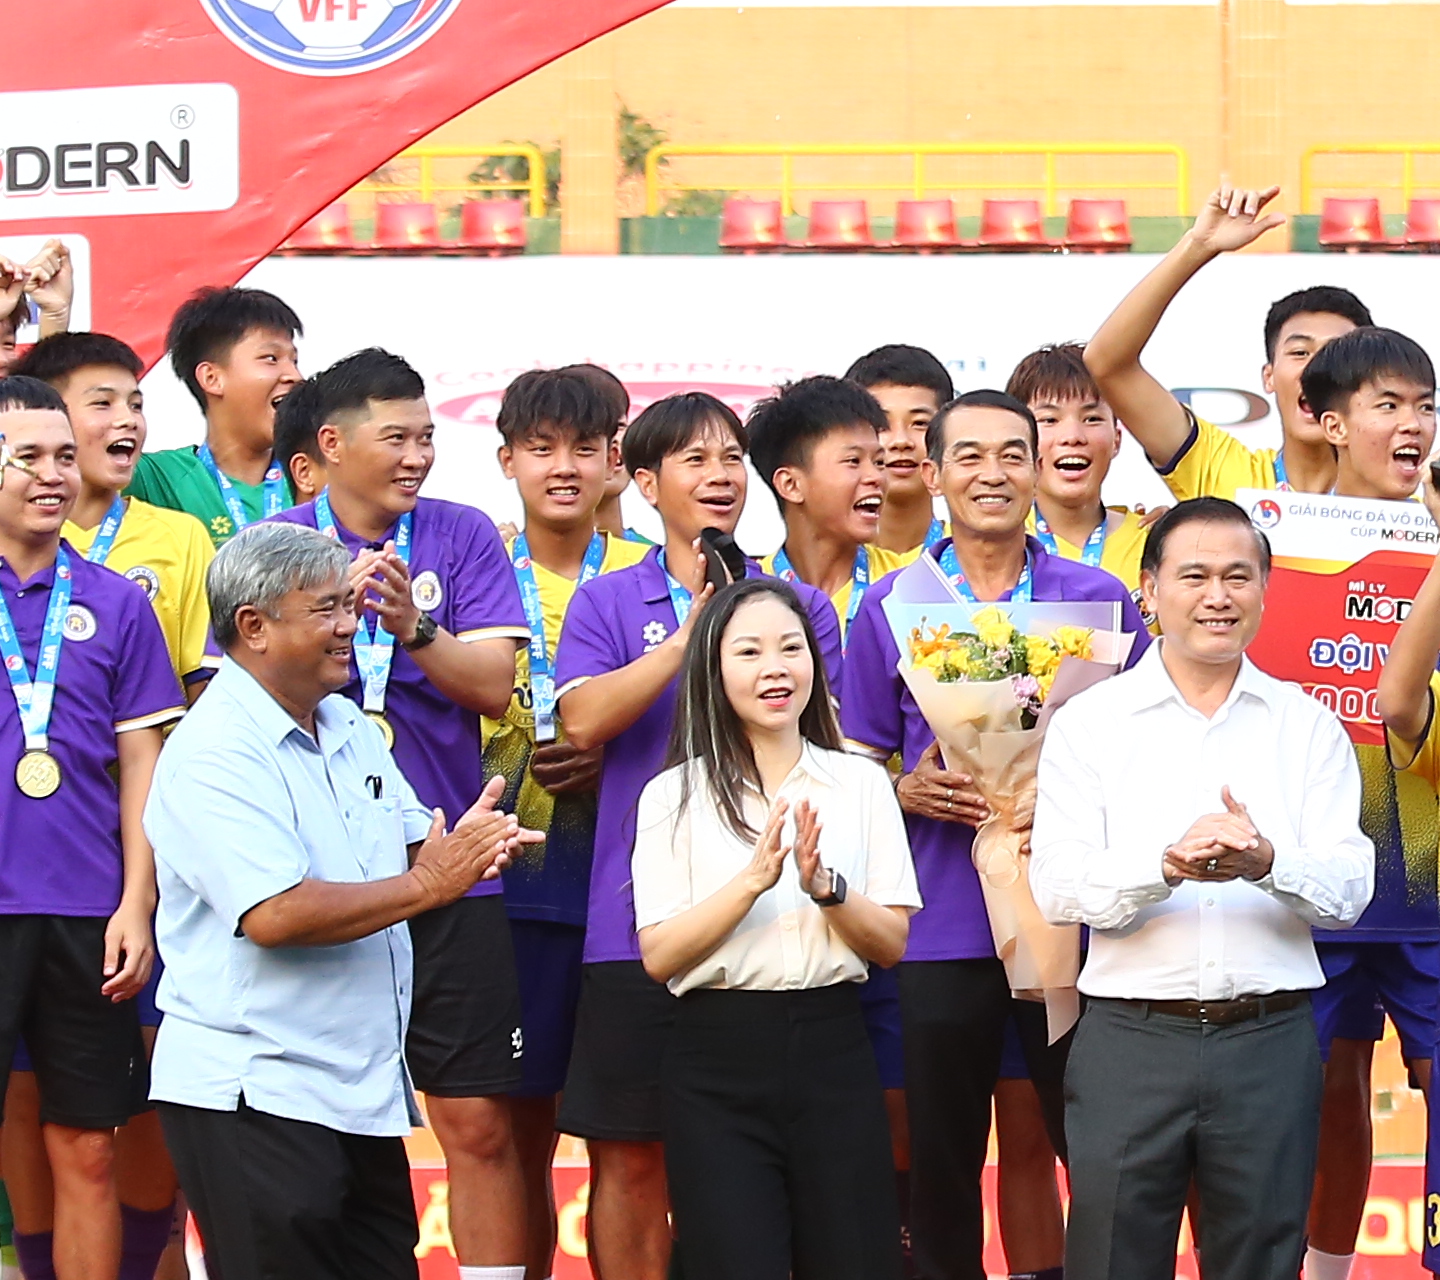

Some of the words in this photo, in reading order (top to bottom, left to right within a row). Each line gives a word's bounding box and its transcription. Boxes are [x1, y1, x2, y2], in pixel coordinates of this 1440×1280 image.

[1289, 503, 1317, 516] GIẢI
[1320, 505, 1362, 520] BÓNG
[1365, 509, 1386, 523] ĐÁ
[1390, 511, 1411, 524] VÔ
[396, 523, 411, 547] VFF
[1350, 524, 1377, 538] CÚP
[1369, 582, 1387, 594] LY
[531, 634, 545, 661] VFF
[1311, 634, 1374, 674] ĐỘI
